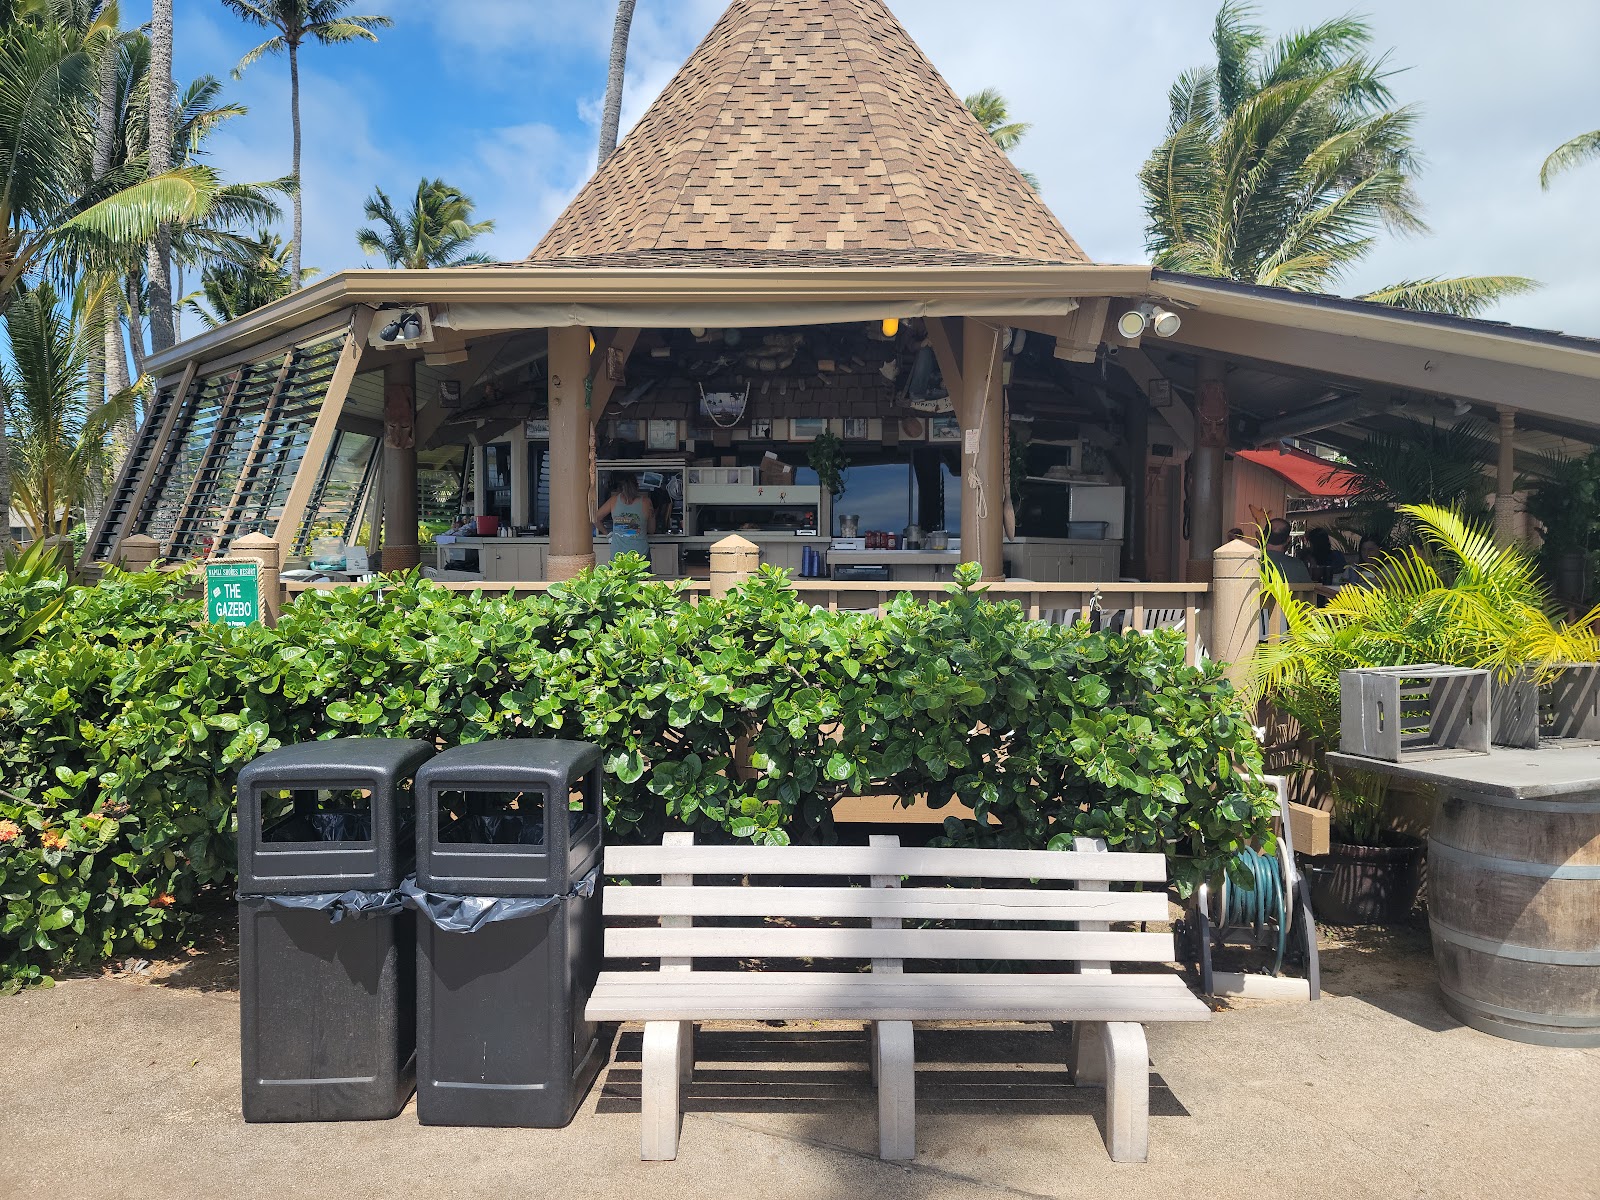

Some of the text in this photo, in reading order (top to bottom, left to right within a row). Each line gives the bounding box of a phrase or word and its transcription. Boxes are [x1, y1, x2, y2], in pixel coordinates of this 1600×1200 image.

[240, 568, 256, 576] RESORT
[224, 583, 242, 599] THE
[216, 601, 252, 617] GAZEBO
